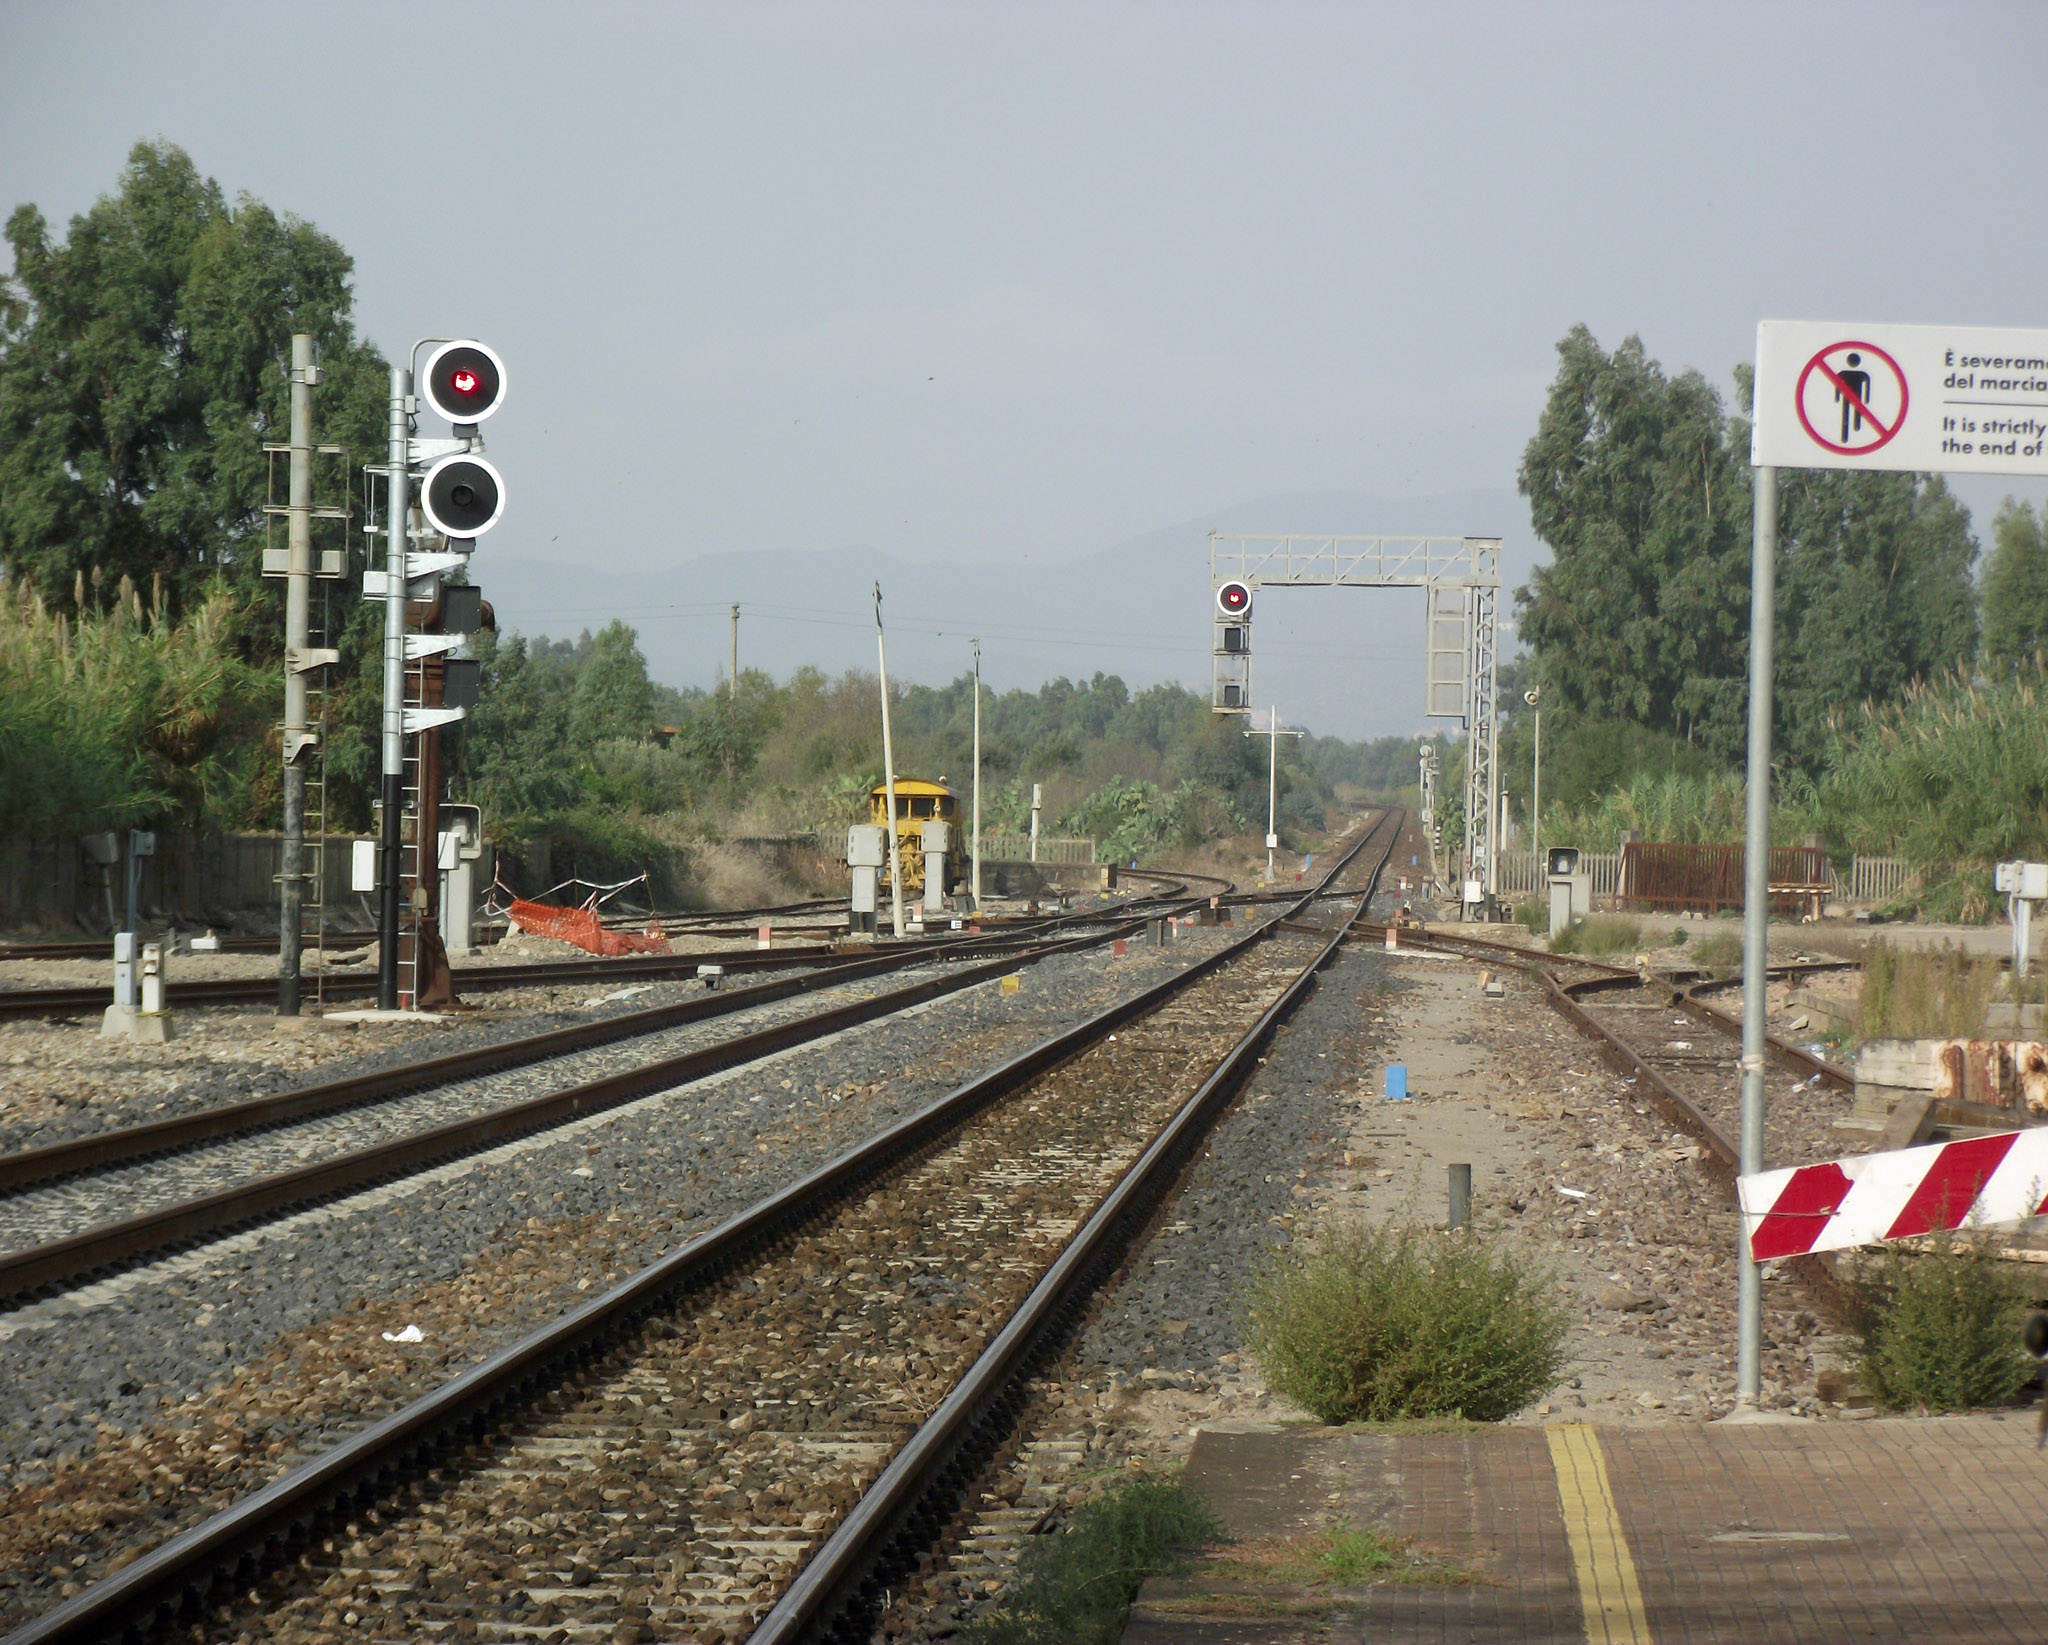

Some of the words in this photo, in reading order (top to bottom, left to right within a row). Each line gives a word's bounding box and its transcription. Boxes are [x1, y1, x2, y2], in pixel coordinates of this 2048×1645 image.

[1944, 372, 1974, 389] del
[1980, 376, 2047, 392] marcia
[1943, 416, 1956, 432] It
[1961, 417, 1976, 433] is
[1982, 419, 2047, 439] strictly
[1942, 437, 1973, 454] the
[1980, 440, 2016, 455] end
[2023, 441, 2043, 456] of
